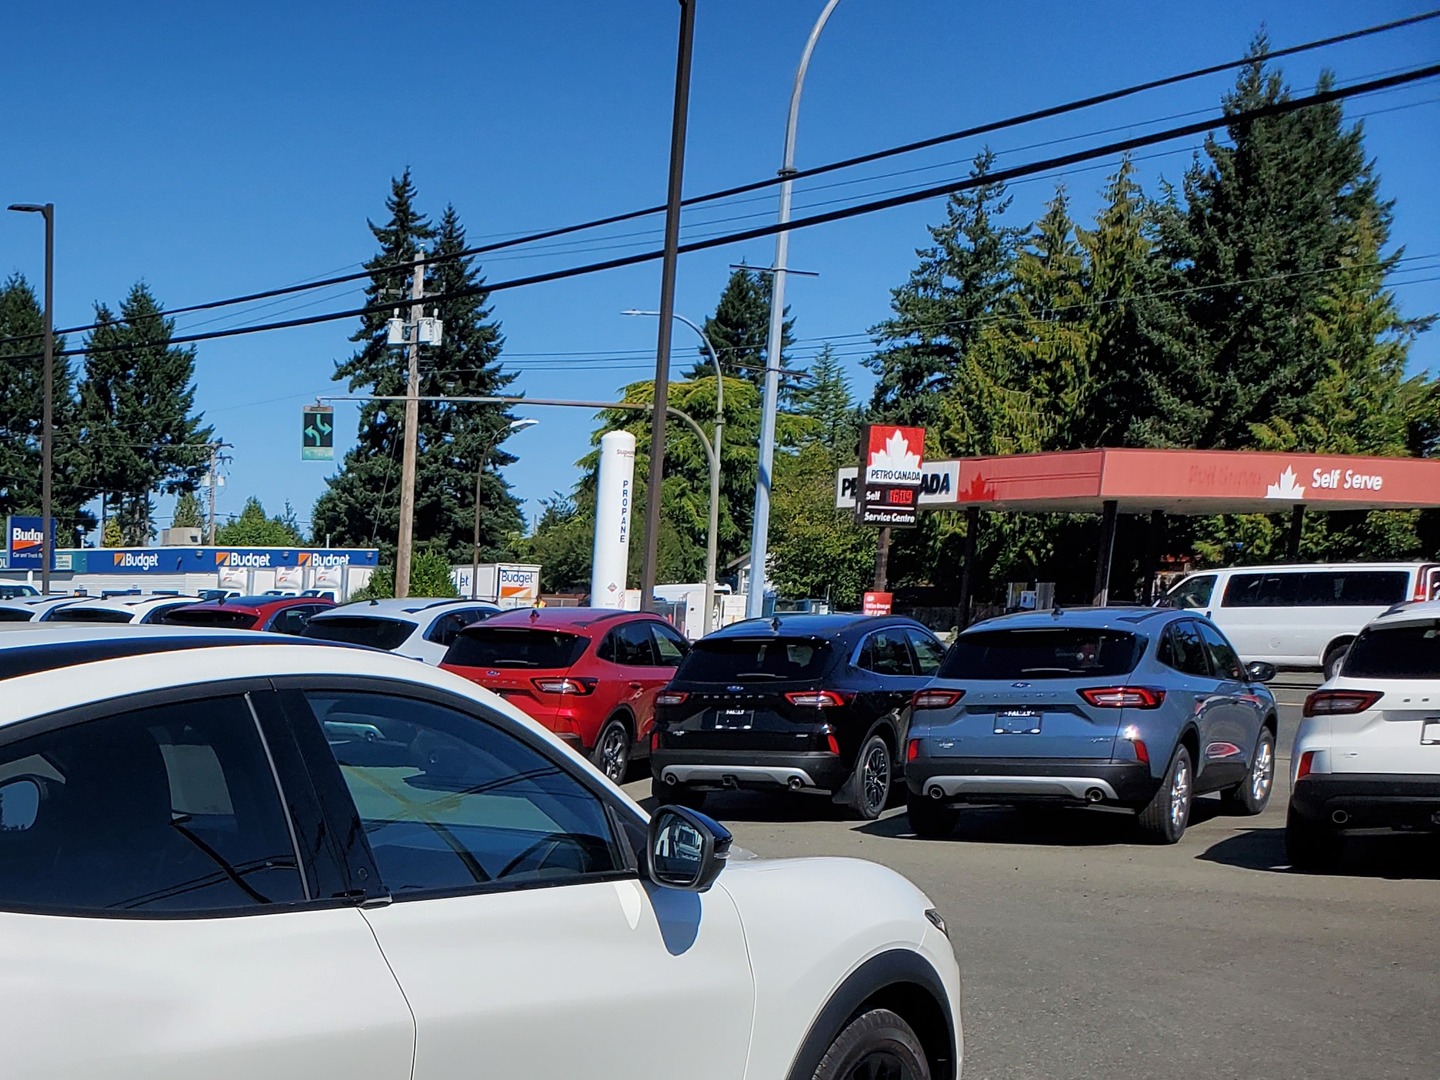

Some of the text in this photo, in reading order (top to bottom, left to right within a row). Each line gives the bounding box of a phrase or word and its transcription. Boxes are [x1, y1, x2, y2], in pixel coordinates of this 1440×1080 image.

[1312, 468, 1383, 491] Self Serve
[866, 490, 881, 501] Self
[619, 480, 629, 543] PROPANE
[864, 511, 891, 522] Service
[13, 527, 44, 544] Budg
[126, 552, 159, 570] Budget
[230, 552, 270, 568] Budget
[501, 571, 533, 586] Budget
